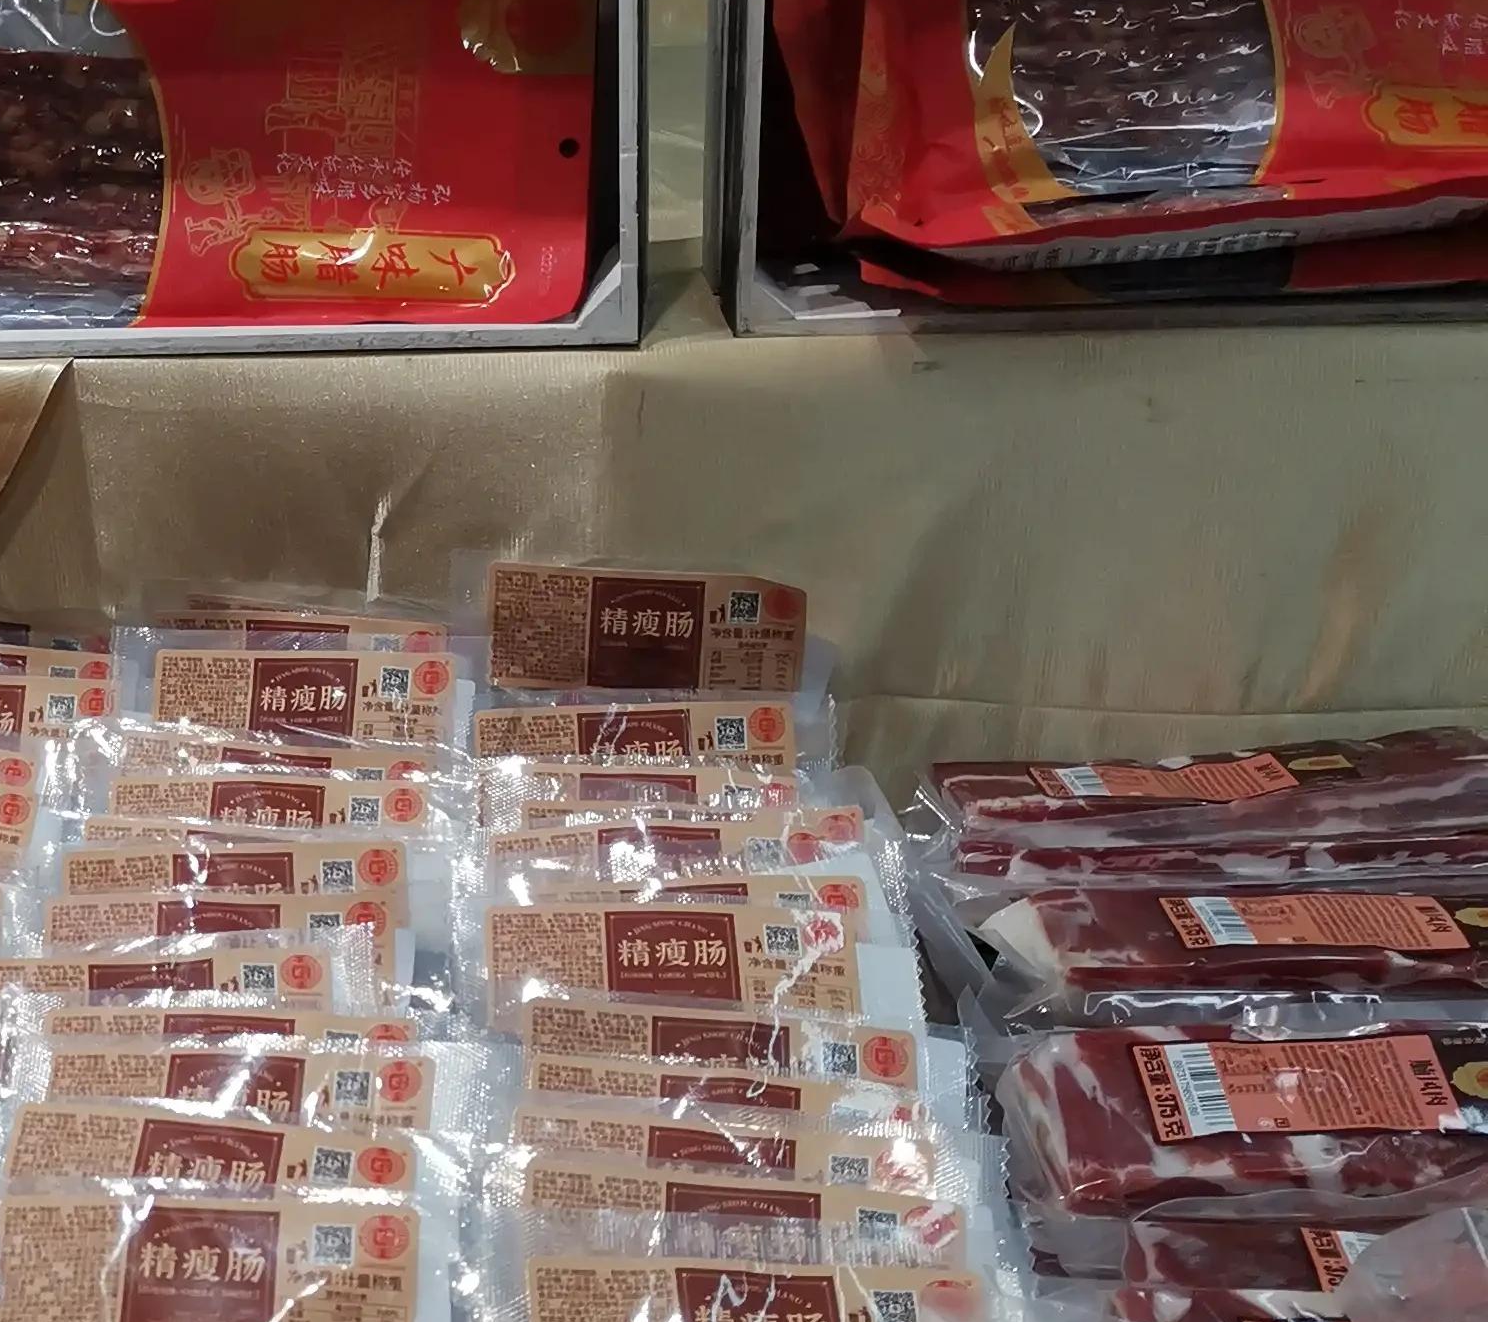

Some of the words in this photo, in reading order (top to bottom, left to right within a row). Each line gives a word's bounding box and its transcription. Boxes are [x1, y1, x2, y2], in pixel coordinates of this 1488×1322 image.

[599, 606, 696, 639] 精瘦肠
[259, 683, 347, 712] 精瘦肠
[617, 937, 728, 968] 精瘦肠
[146, 1151, 267, 1193] 精瘦肠
[139, 1241, 267, 1282] 精瘦肠
